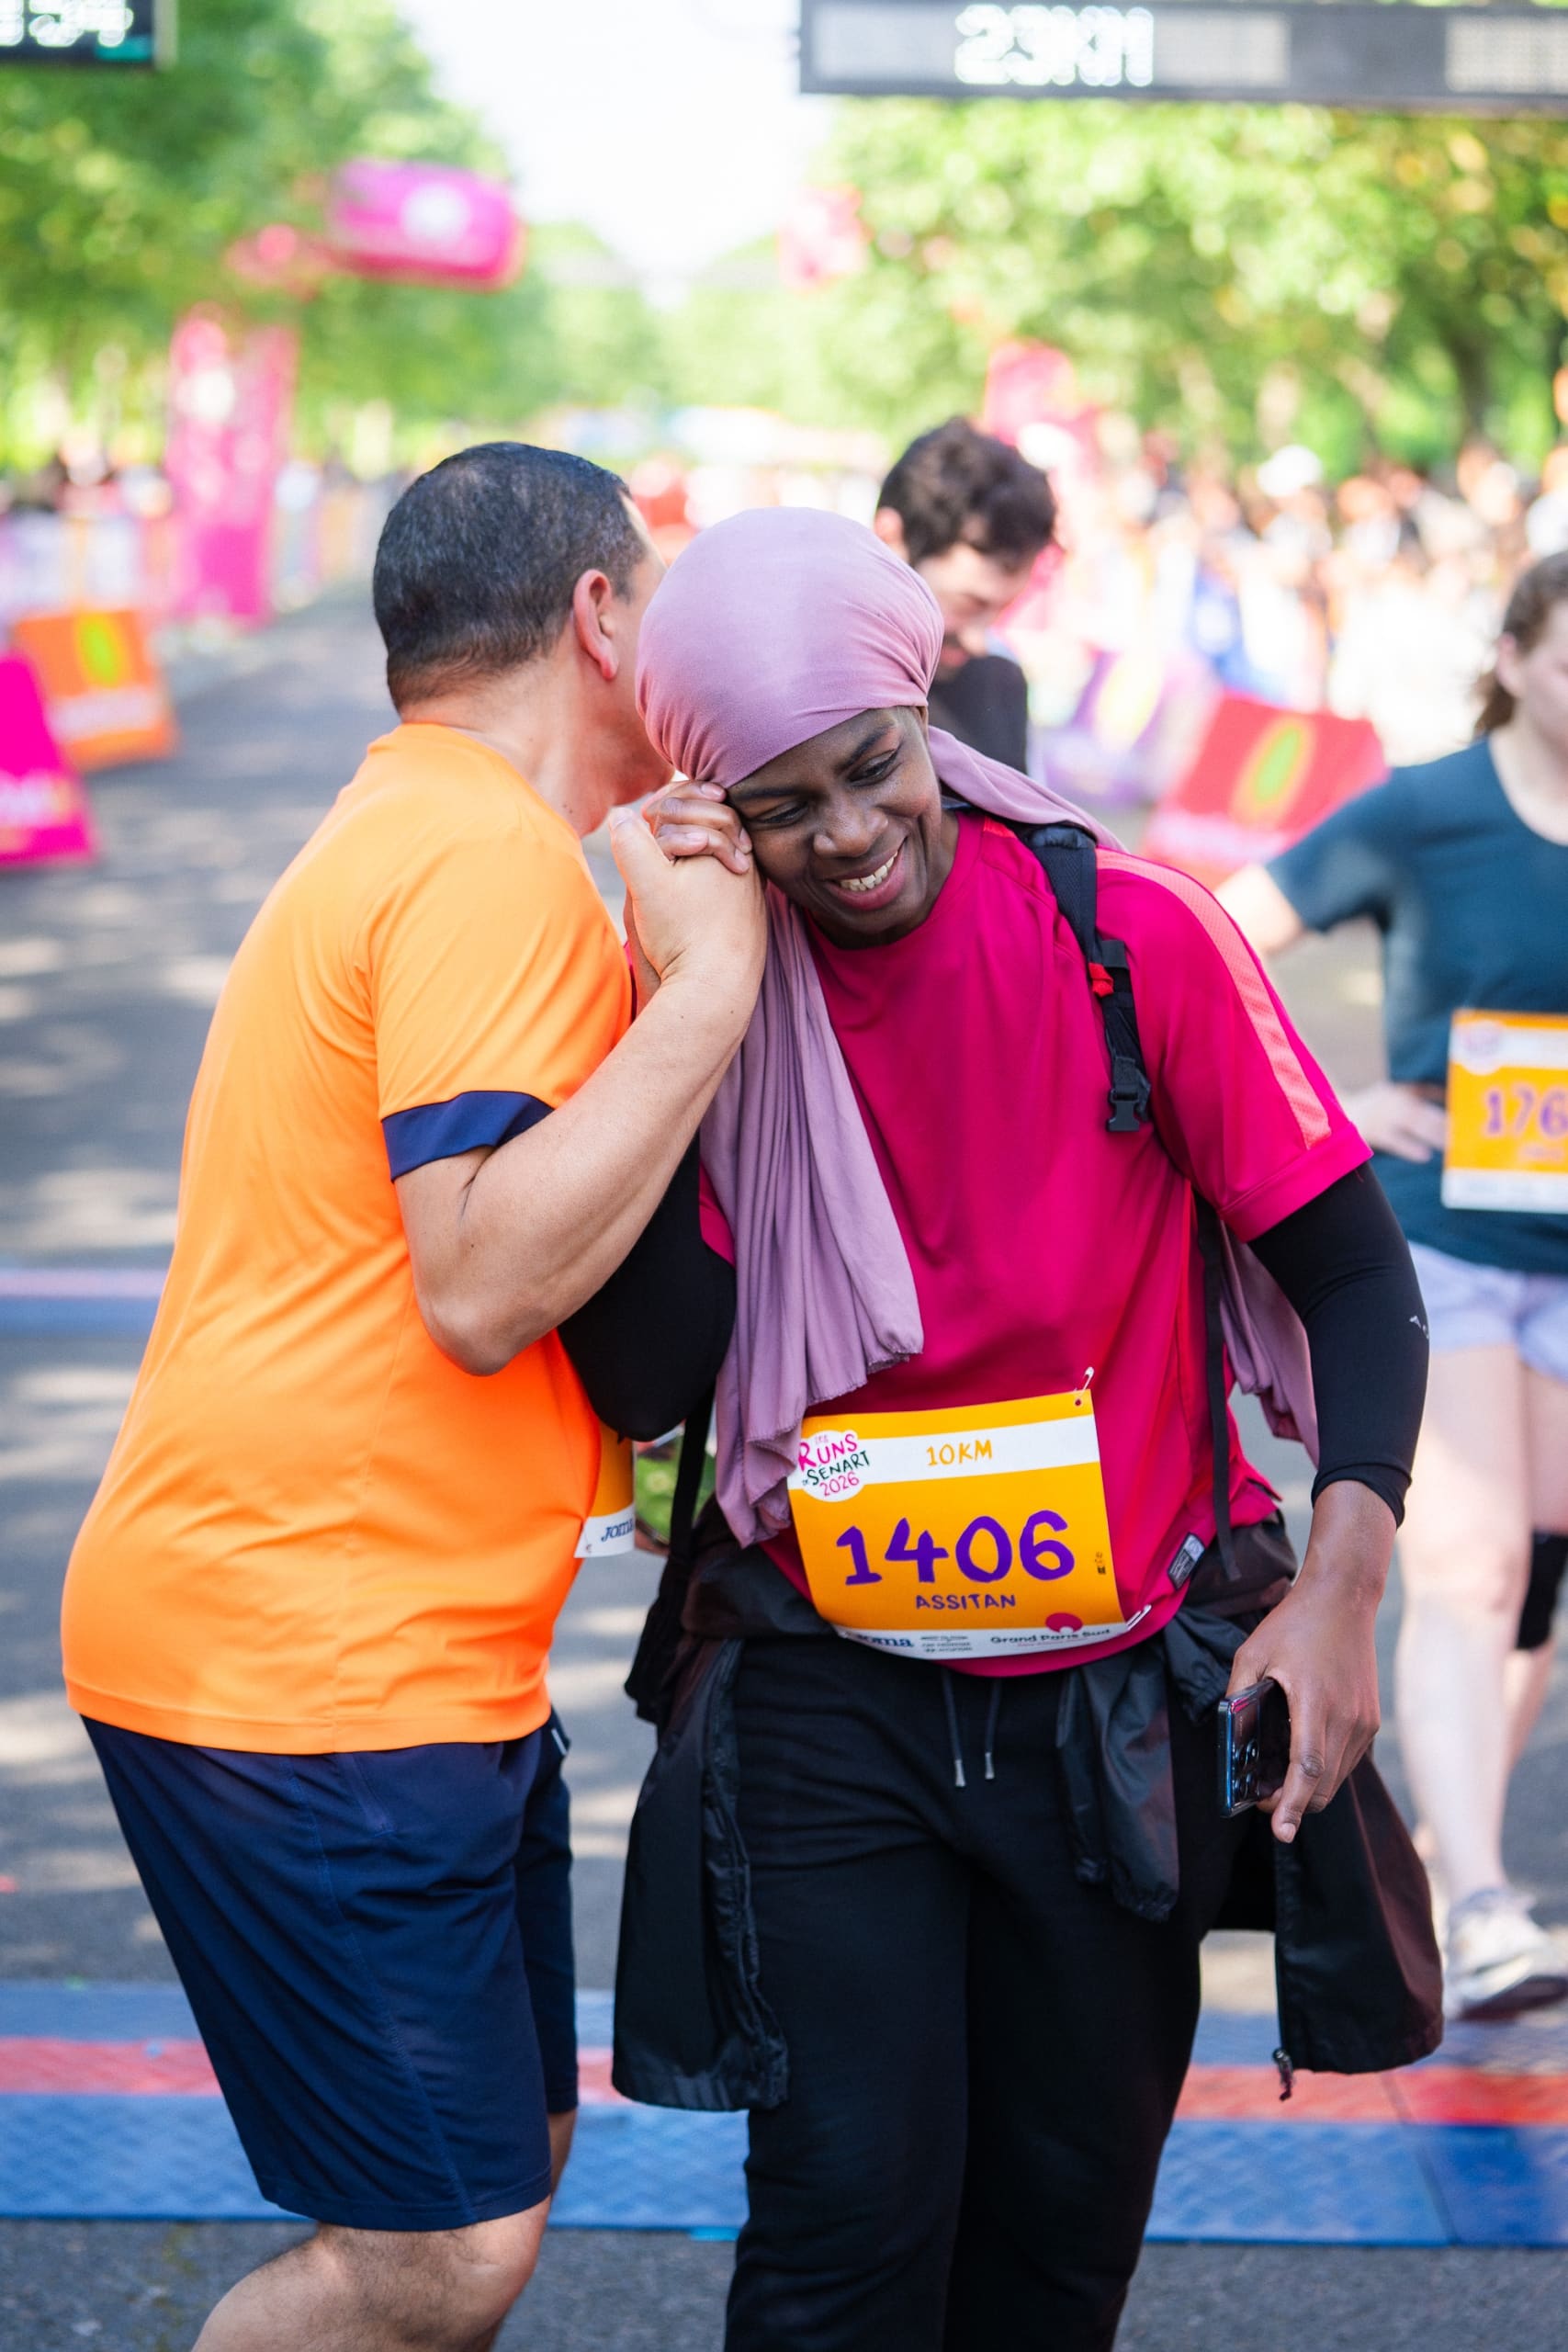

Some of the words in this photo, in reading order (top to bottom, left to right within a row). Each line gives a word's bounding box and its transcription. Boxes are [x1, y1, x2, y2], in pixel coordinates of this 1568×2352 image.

[798, 1433, 858, 1472] RUNS
[927, 1439, 993, 1466] 10KM
[819, 1471, 860, 1498] 2026
[836, 1510, 1075, 1586] 1406
[916, 1593, 1016, 1611] ASSITAN
[990, 1634, 1037, 1644] Grand
[1041, 1633, 1079, 1642] Paris
[1082, 1628, 1111, 1638] Sud
